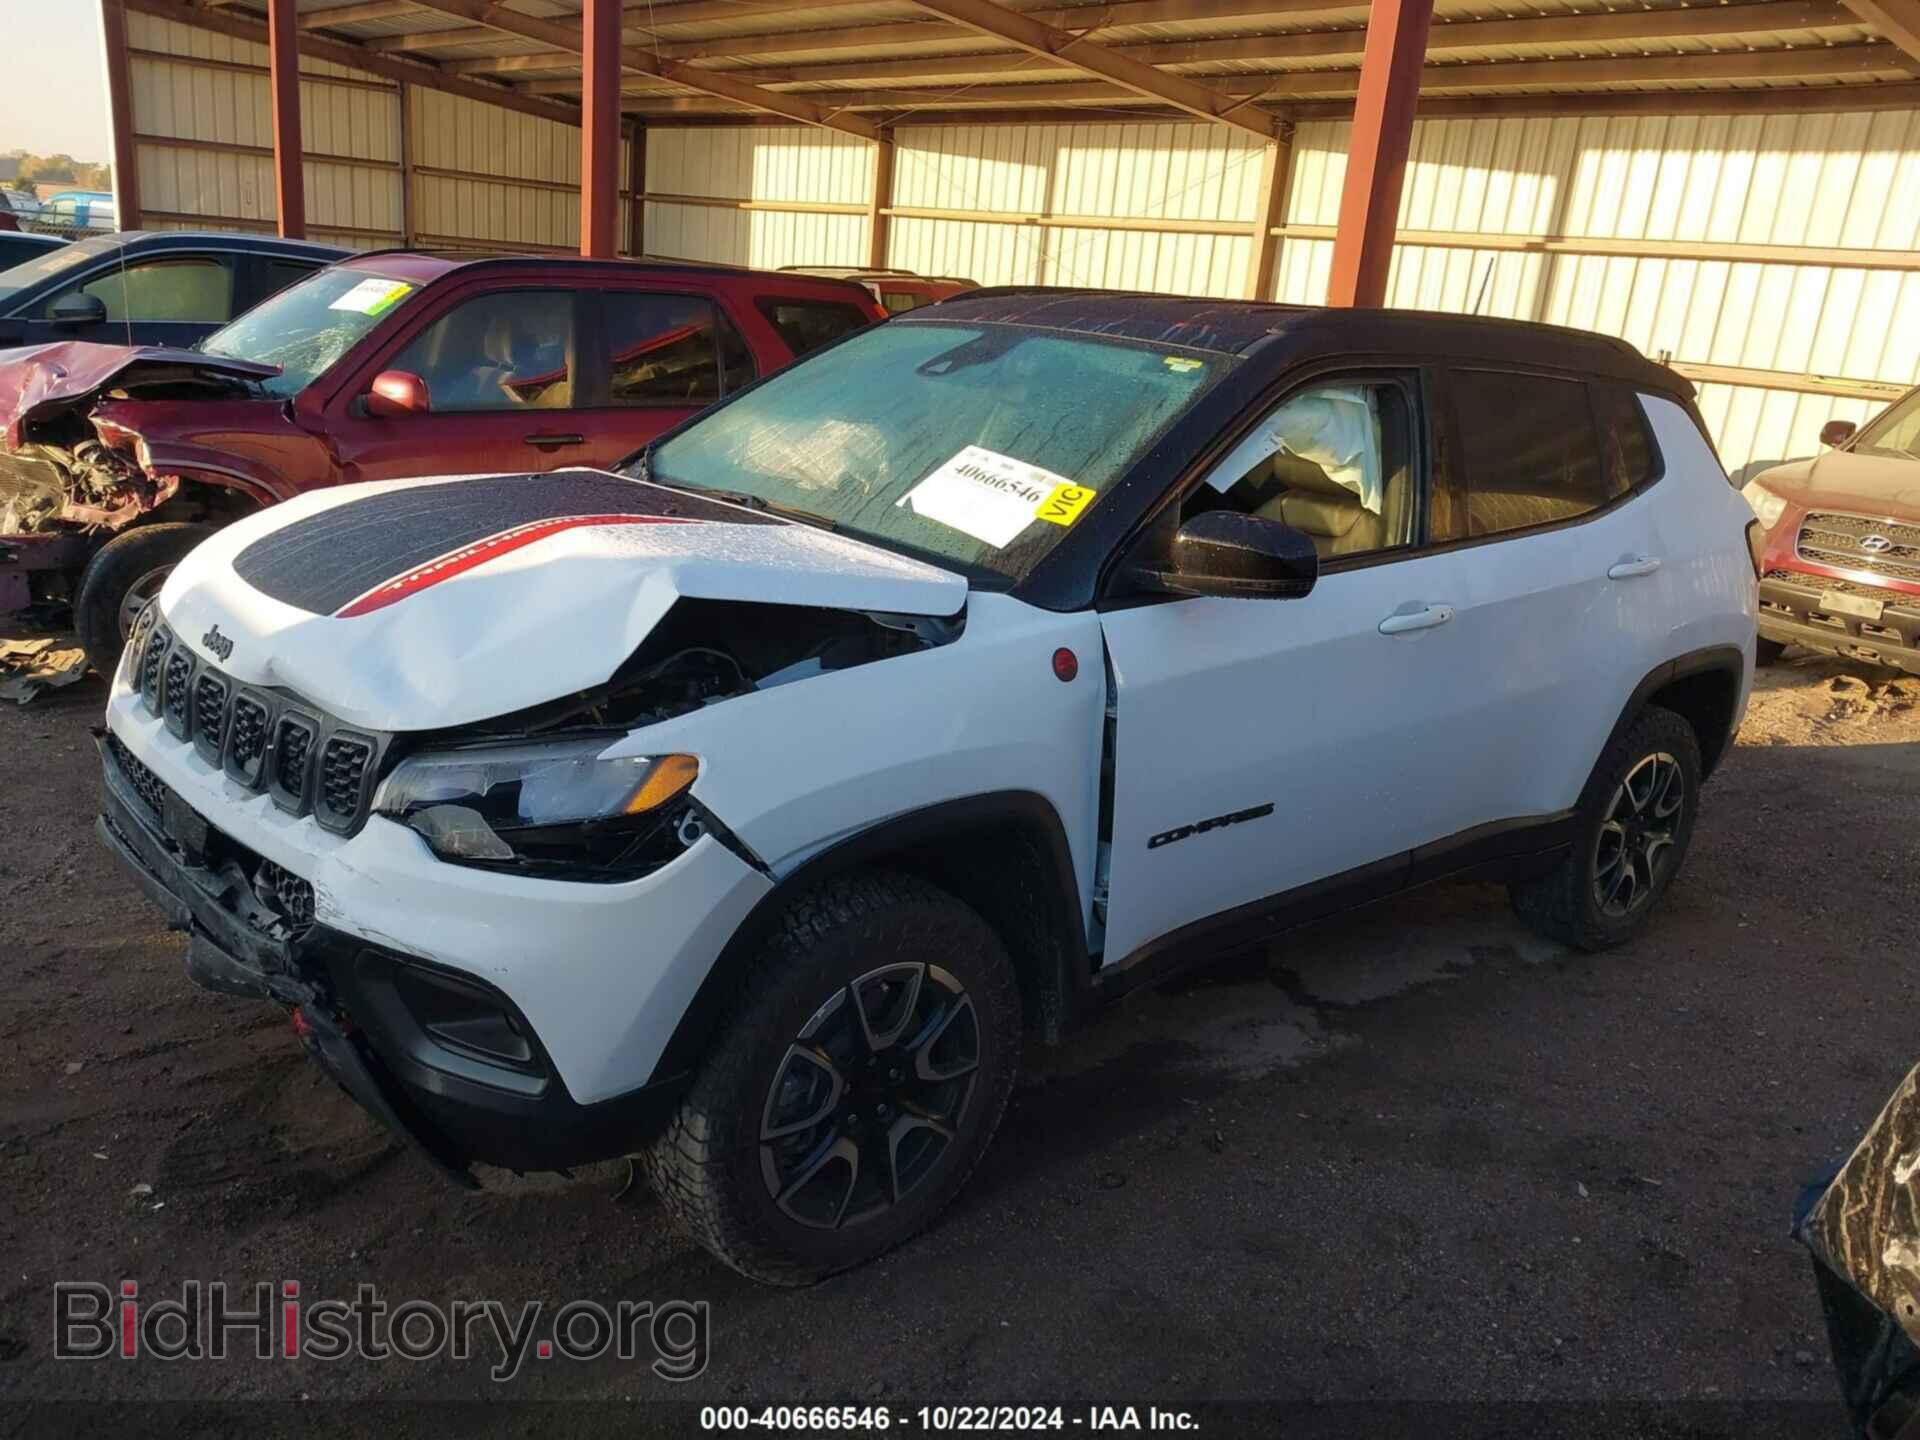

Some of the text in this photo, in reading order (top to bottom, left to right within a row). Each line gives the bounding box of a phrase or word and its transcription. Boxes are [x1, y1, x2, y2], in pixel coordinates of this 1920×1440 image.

[955, 463, 1040, 503] 40666546
[1045, 487, 1083, 517] VIC
[202, 623, 234, 664] Jeep
[1147, 802, 1275, 849] COMPASS
